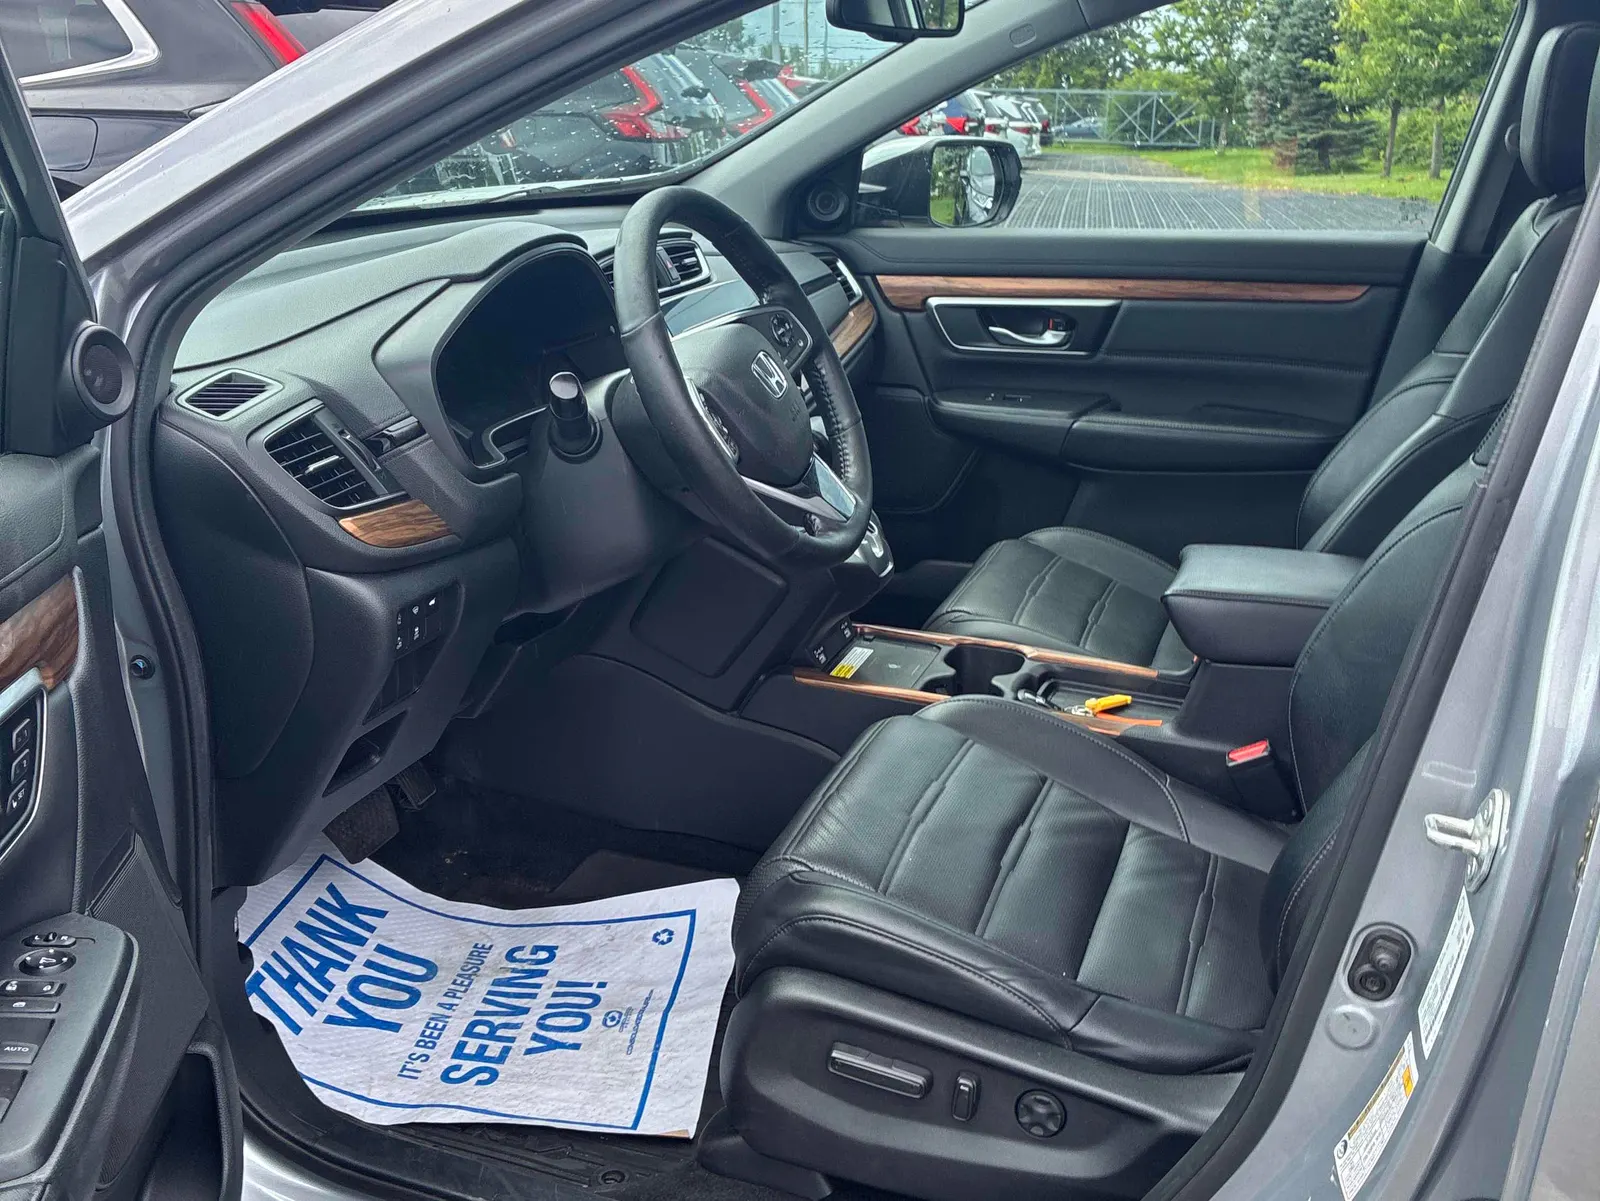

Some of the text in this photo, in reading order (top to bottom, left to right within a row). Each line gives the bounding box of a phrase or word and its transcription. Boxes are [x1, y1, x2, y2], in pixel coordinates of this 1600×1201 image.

[244, 882, 389, 1037] THANK
[322, 942, 439, 1034] YOU
[396, 942, 494, 1080] IT'S BEEN A PLEASURE
[439, 943, 560, 1087] SERVING
[523, 980, 609, 1056] YOU!
